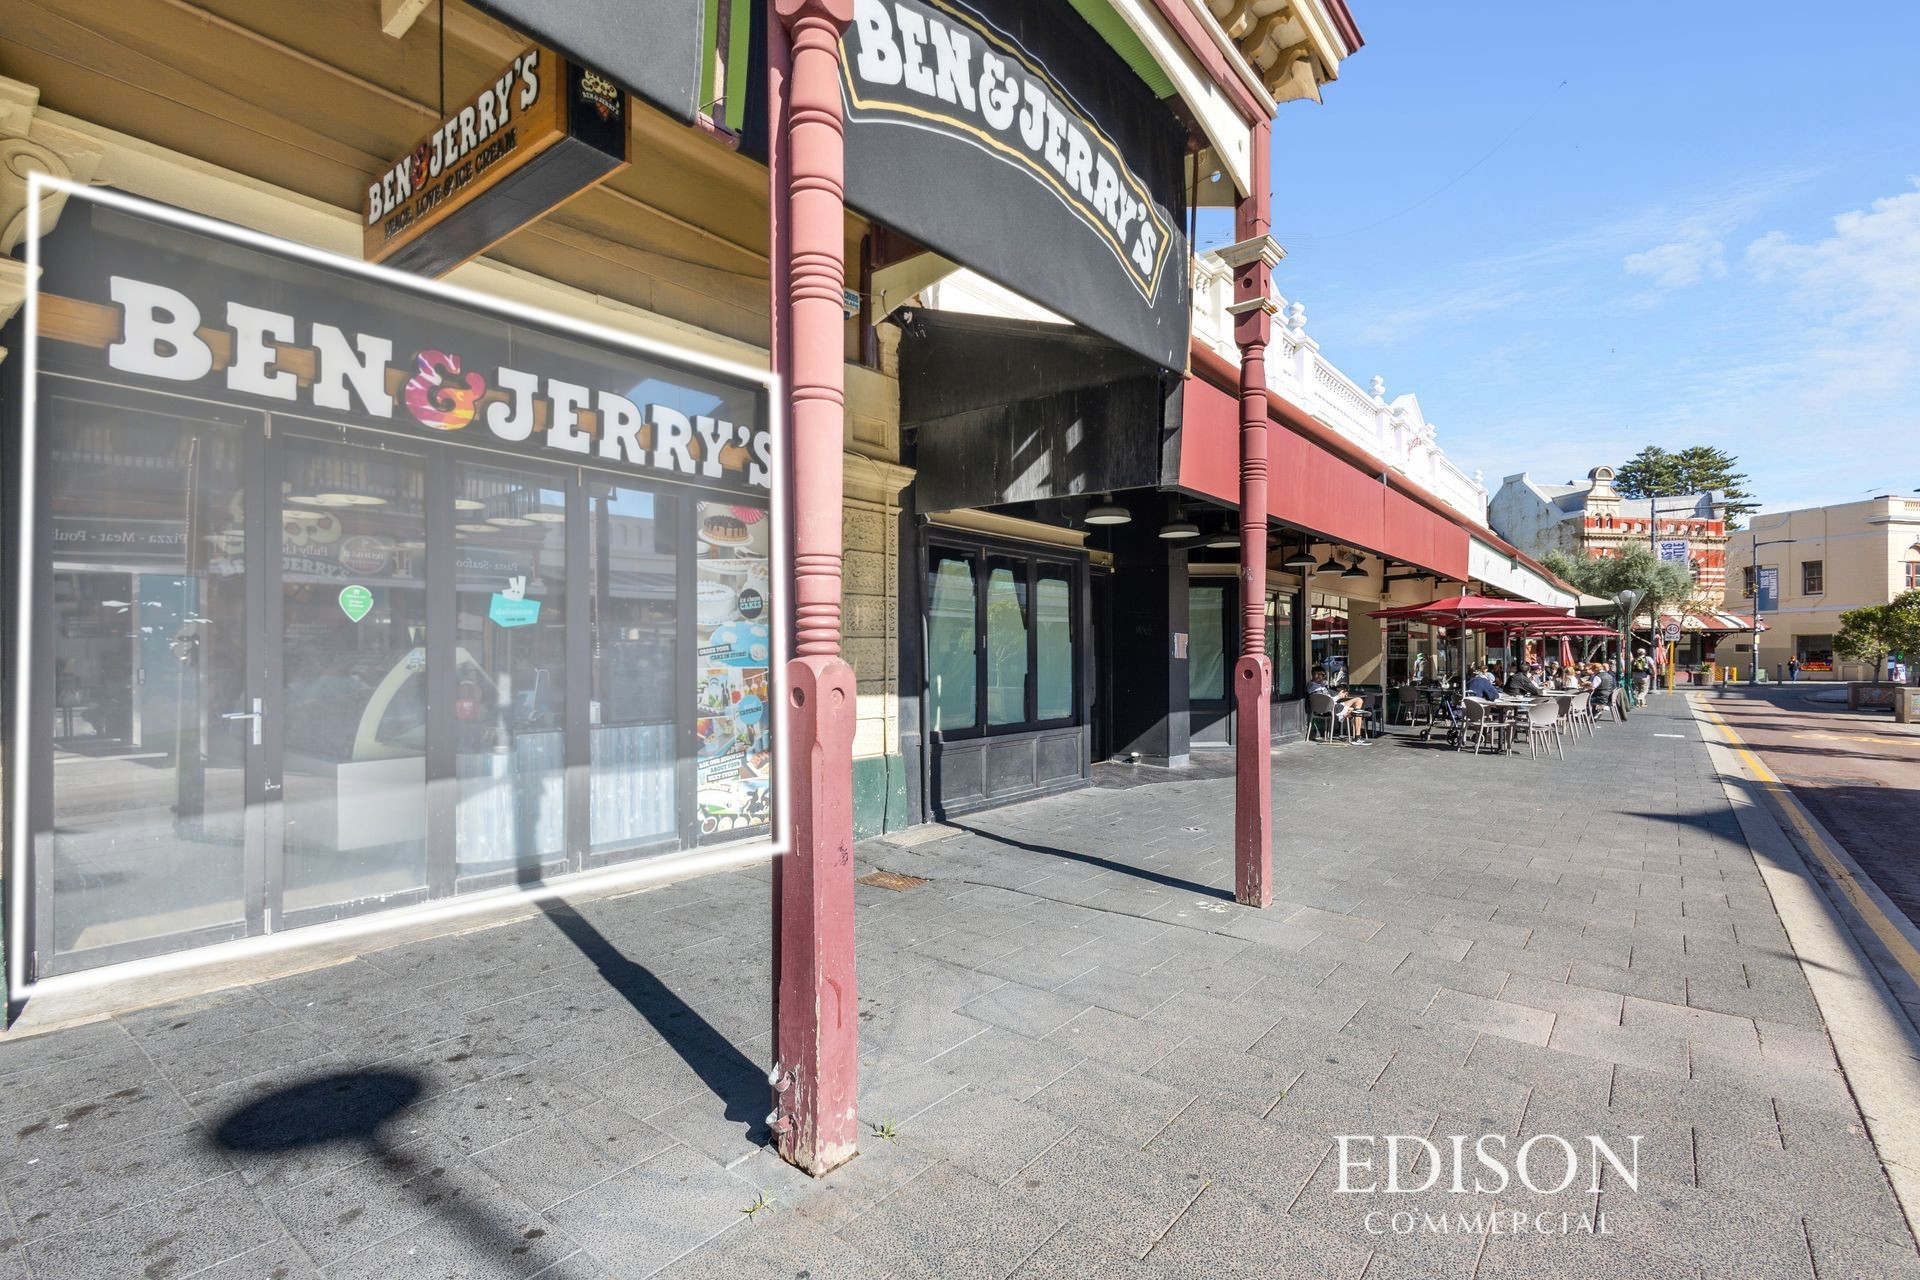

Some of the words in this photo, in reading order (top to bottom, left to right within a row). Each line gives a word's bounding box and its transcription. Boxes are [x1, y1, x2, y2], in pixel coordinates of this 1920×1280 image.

[369, 155, 411, 225] BEN
[411, 142, 431, 191] &
[430, 50, 541, 178] JERRY'S
[854, 0, 976, 112] BEN
[979, 51, 1019, 131] &
[1019, 80, 1157, 276] JERRY'S
[415, 183, 442, 218] LOVE
[455, 161, 474, 190] ICE
[474, 127, 518, 175] CREAM
[109, 275, 392, 418] BEN
[404, 348, 487, 431] &
[486, 366, 771, 489] JERRY'S
[739, 601, 762, 610] CAKES
[699, 647, 717, 655] ORDER
[739, 707, 761, 715] CATERING
[710, 764, 728, 773] ABOUT
